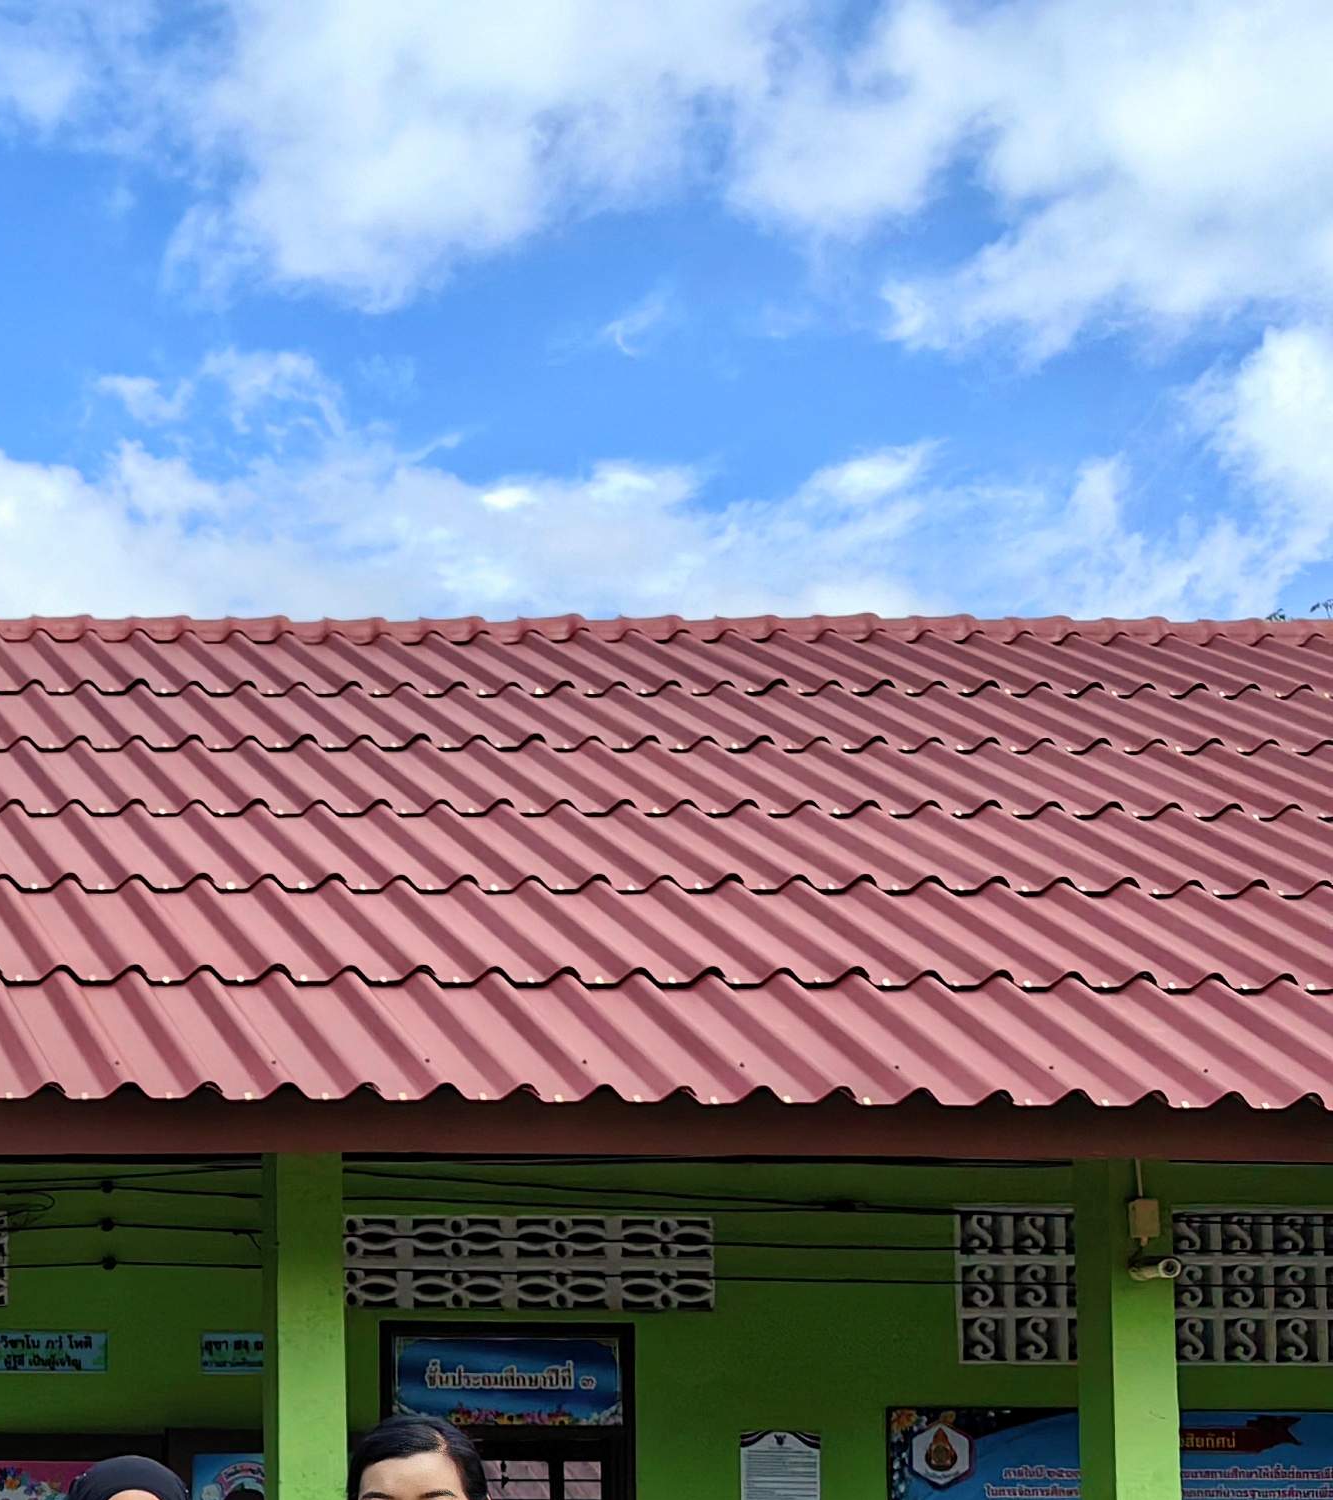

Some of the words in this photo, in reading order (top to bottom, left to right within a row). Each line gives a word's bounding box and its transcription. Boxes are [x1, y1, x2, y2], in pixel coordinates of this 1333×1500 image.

[426, 1359, 574, 1389] ชั้นประถมศึกษาปีที่
